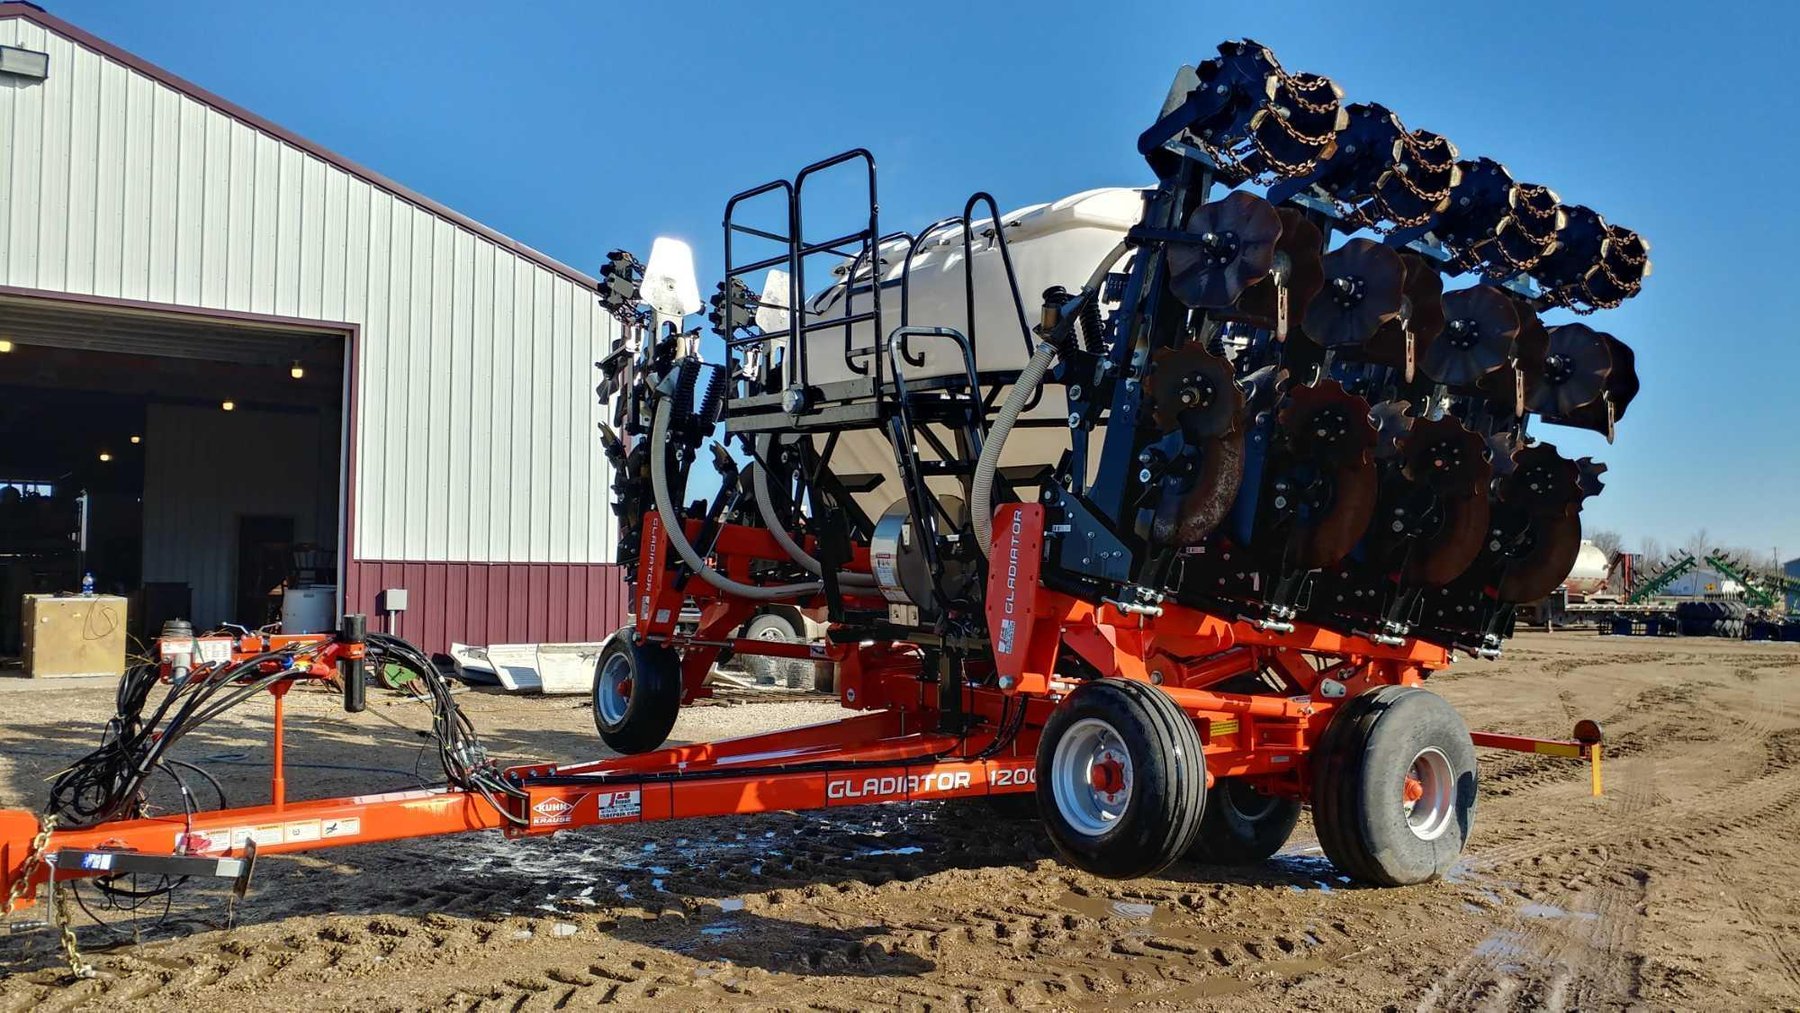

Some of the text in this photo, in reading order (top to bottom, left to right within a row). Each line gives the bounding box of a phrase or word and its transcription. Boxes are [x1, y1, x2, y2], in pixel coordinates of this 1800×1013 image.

[646, 518, 658, 592] GLADIATOR
[1005, 509, 1022, 614] GLADIATOR
[827, 771, 971, 798] GLADIATOR
[533, 816, 572, 824] KRAUSE
[538, 803, 568, 811] KUHN
